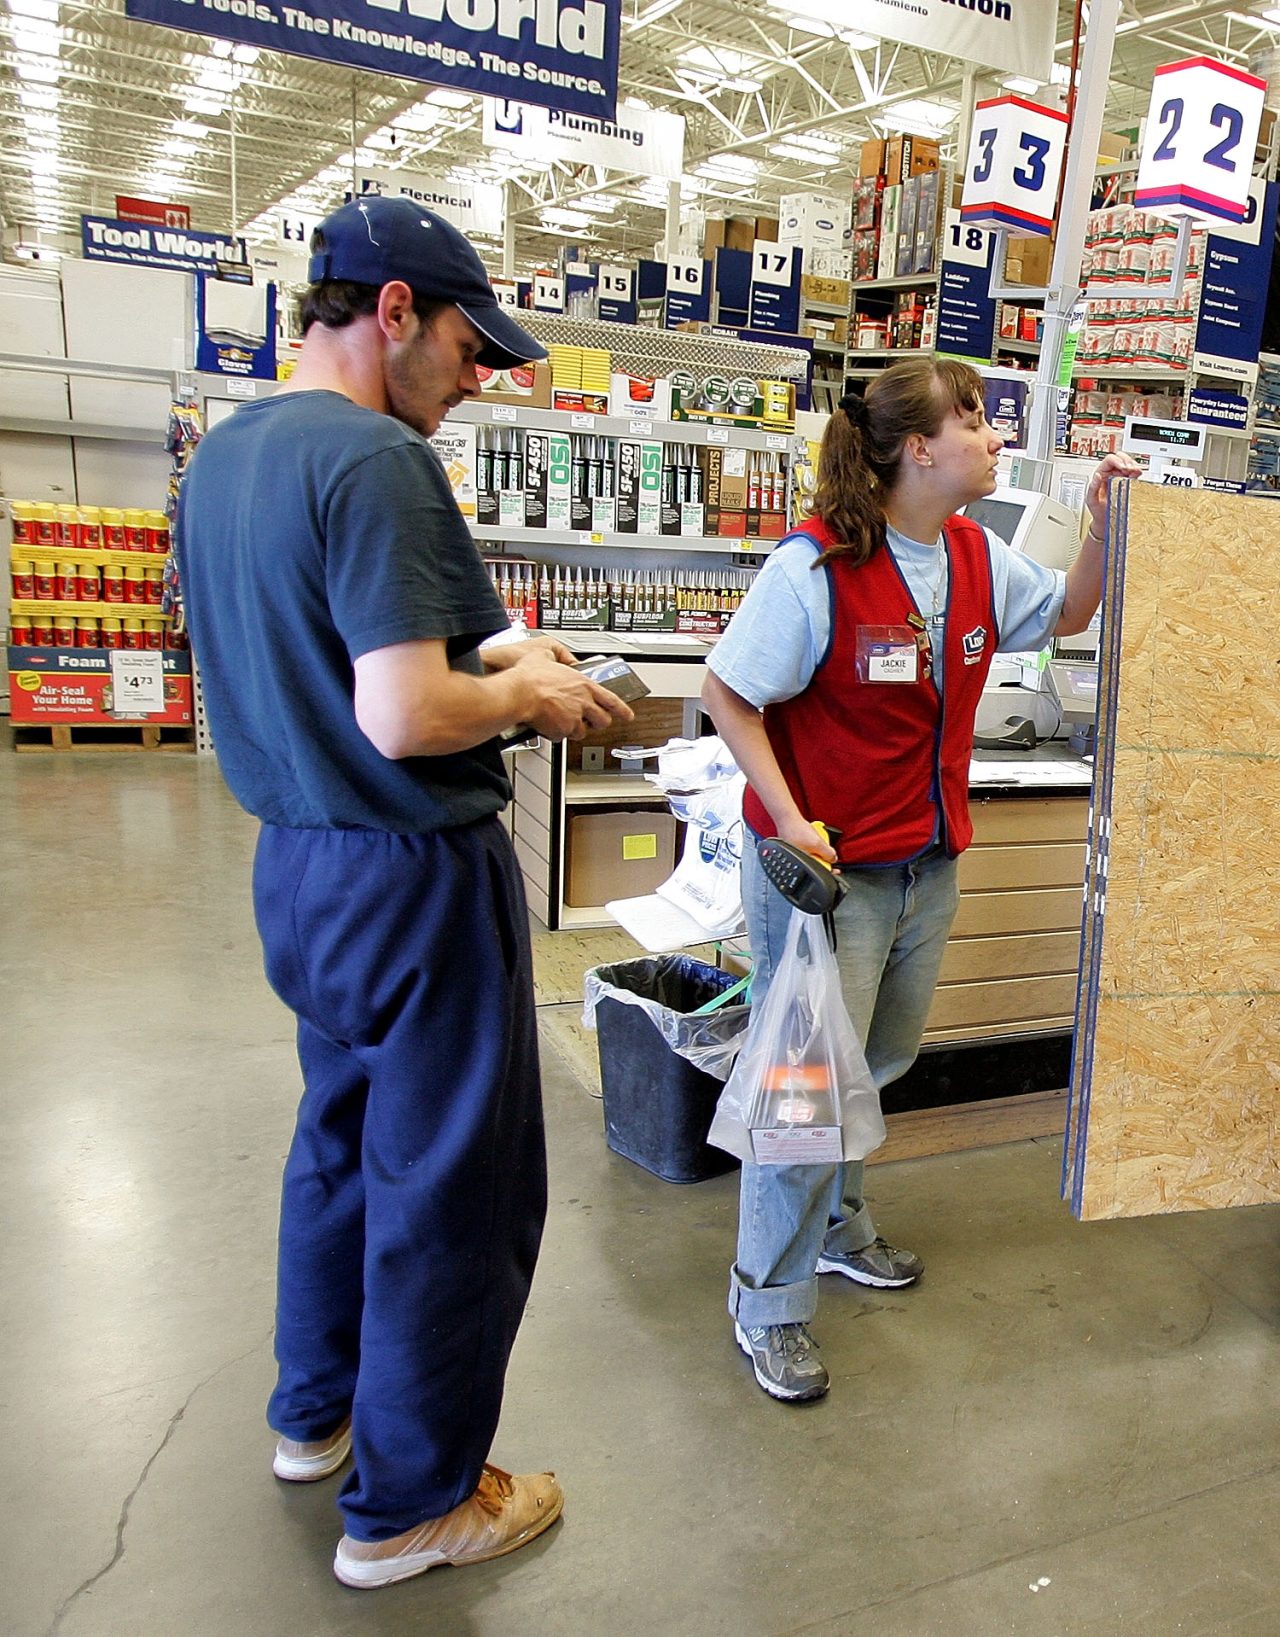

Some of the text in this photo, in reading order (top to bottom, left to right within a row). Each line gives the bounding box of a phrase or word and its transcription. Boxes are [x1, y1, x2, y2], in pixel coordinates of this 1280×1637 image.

[282, 6, 330, 34] The
[332, 17, 477, 67] Knowledge.
[479, 51, 521, 76] The
[522, 61, 607, 96] Source.
[548, 108, 644, 146] Plumbing
[1152, 98, 1184, 161] 2
[1203, 102, 1243, 172] 2
[973, 128, 998, 183] 3
[1013, 132, 1051, 192] 3
[400, 186, 473, 209] Electrical
[87, 222, 243, 263] Tool World
[950, 224, 983, 251] 18
[759, 252, 788, 273] 17
[672, 264, 699, 283] 16
[537, 285, 560, 300] 14
[603, 275, 628, 293] 15
[496, 291, 515, 305] 13
[712, 327, 738, 337] KOBALT
[218, 357, 254, 371] Gloves
[1198, 360, 1248, 375] Visit Lowes.com
[1190, 403, 1247, 422] Guaranteed
[550, 437, 570, 485] OSI
[641, 445, 662, 491] OSI
[708, 450, 721, 506] PROJECTS
[58, 655, 106, 668] Foam
[881, 659, 906, 668] JACKIE
[39, 685, 86, 696] Air-Seal
[32, 696, 93, 706] Your Home
[47, 706, 77, 714] Insulating
